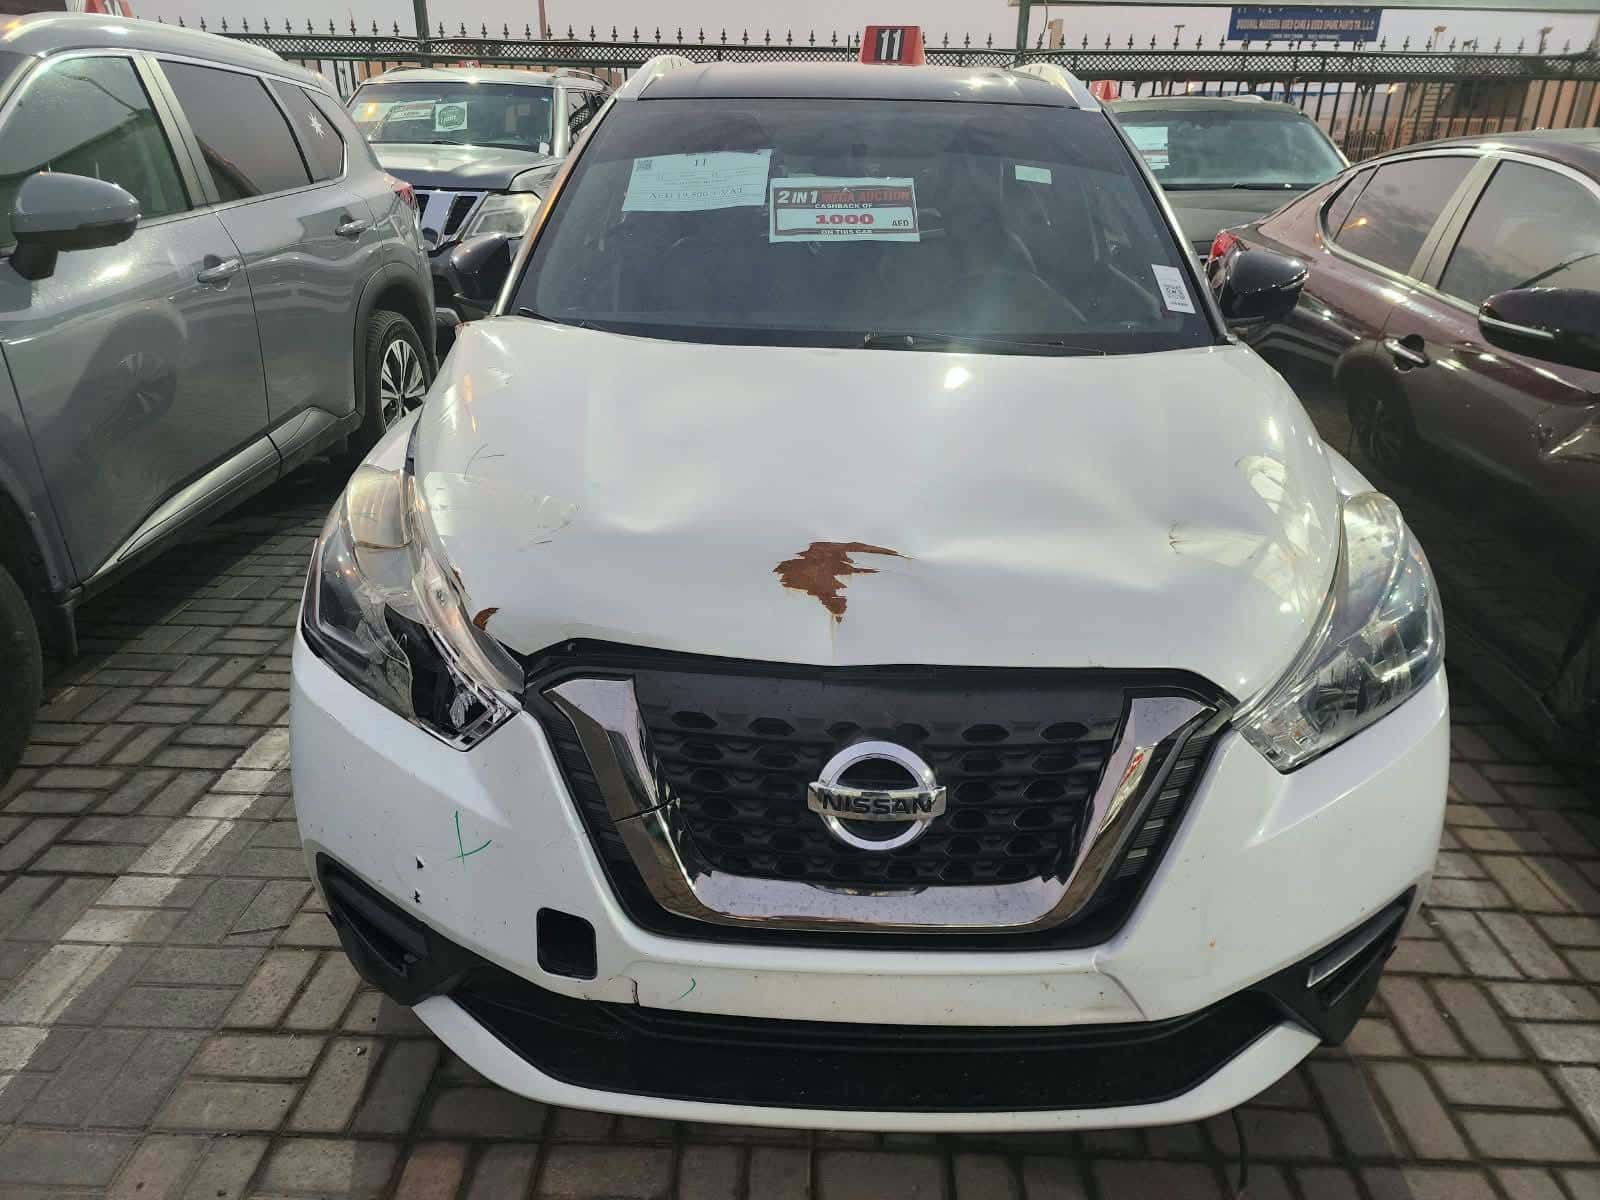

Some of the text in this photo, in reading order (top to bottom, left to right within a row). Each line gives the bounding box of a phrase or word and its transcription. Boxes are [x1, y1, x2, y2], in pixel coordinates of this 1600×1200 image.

[881, 29, 902, 60] 11
[777, 190, 789, 203] 2
[791, 191, 807, 203] IN
[809, 190, 819, 203] 1
[891, 219, 910, 227] AED
[819, 789, 933, 815] NISSAN
